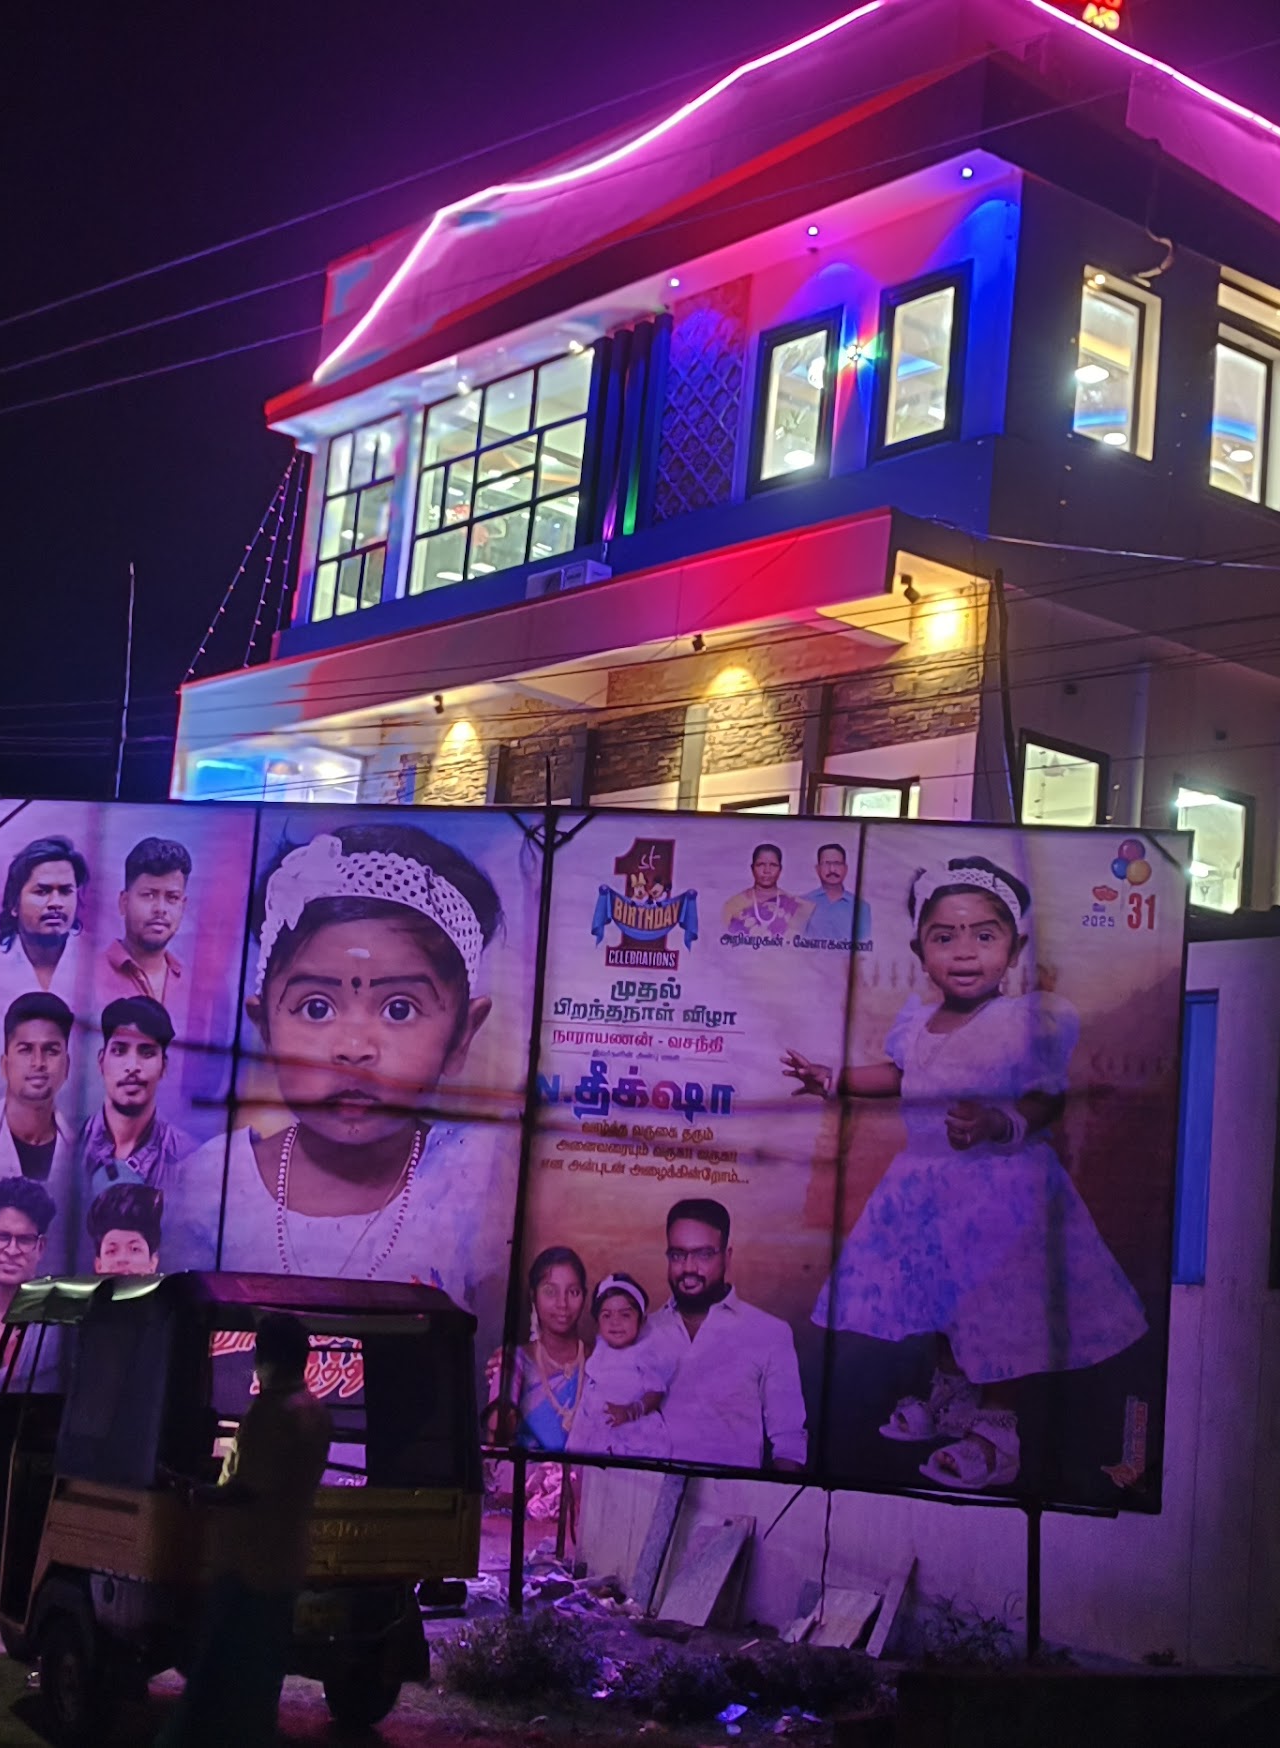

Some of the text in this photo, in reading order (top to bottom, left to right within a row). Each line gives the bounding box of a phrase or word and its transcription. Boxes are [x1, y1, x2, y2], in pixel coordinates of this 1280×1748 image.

[613, 896, 680, 930] BIRTHDAY
[1081, 914, 1116, 928] 2025
[1127, 892, 1157, 931] 31
[608, 949, 676, 968] CELEBRATIONS
[610, 976, 682, 1003] முதல்
[553, 997, 738, 1028] பிறந்தநாள் விழா
[552, 1028, 654, 1049] நாராயணன்
[667, 1034, 725, 1054] வசந்தி
